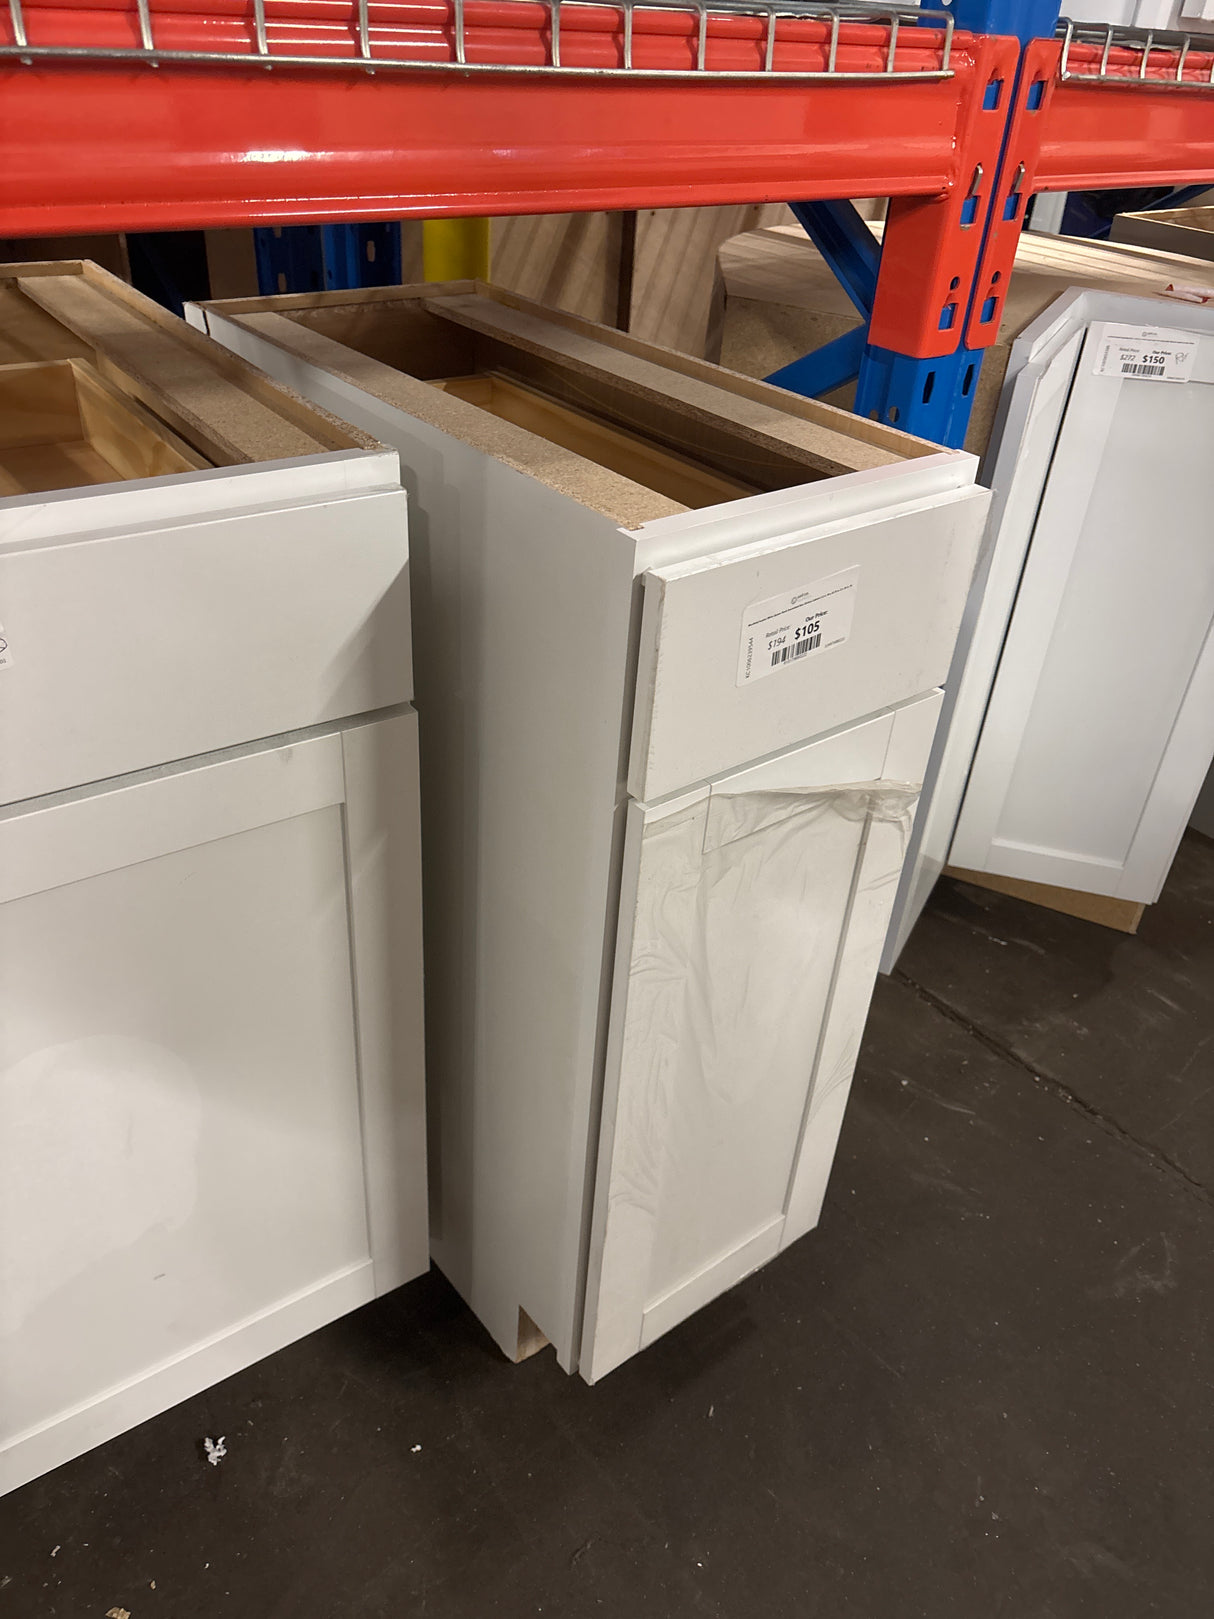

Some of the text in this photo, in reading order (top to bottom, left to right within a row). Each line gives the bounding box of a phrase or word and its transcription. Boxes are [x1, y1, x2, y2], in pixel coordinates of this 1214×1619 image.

[1142, 355, 1165, 364] $150
[815, 610, 828, 619] Price:
[765, 629, 779, 638] Retail
[794, 620, 820, 640] $105
[767, 635, 786, 650] $194
